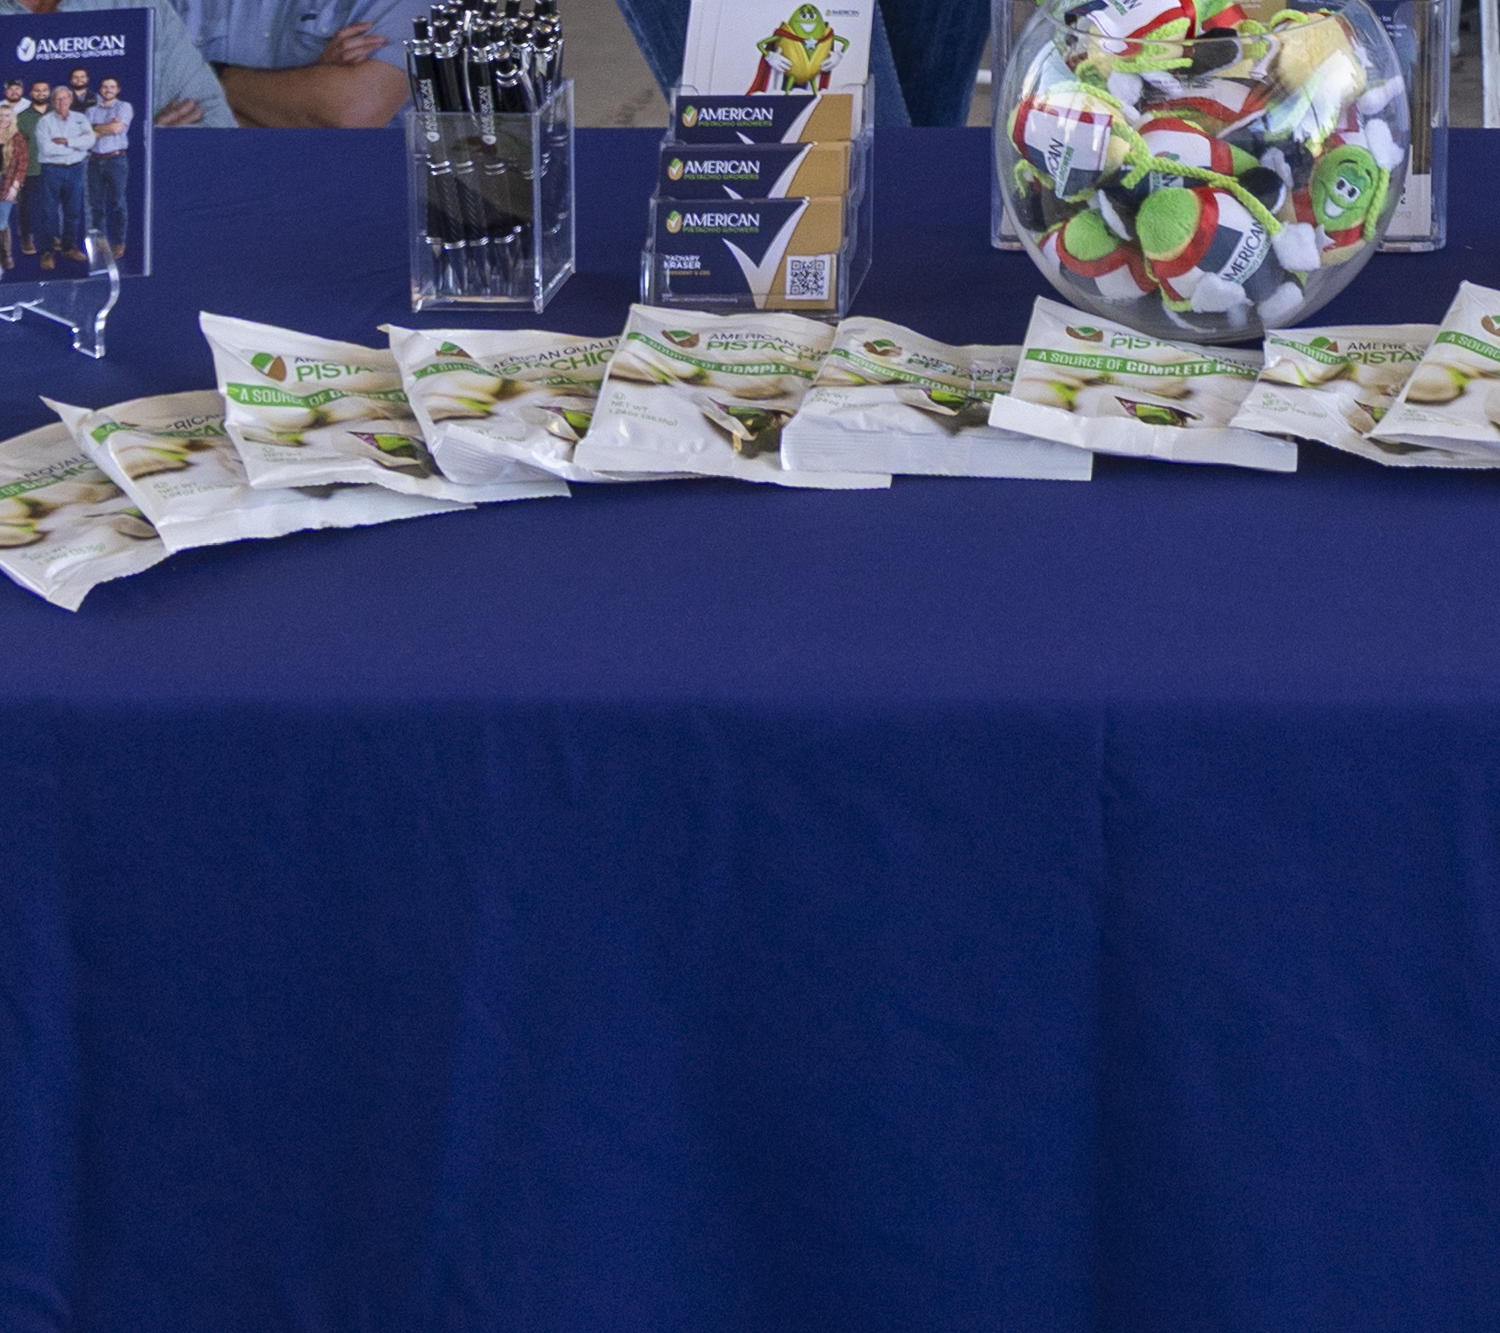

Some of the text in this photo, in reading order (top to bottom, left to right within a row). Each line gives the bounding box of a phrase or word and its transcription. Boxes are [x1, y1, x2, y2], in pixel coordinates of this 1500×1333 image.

[36, 35, 126, 53] AMERICAN
[698, 107, 773, 121] AMERICAN
[684, 160, 760, 175] AMERICAN
[683, 213, 760, 227] AMERICAN
[1448, 333, 1456, 342] A
[563, 338, 620, 356] QUALIT
[1038, 350, 1048, 361] A
[1050, 352, 1101, 369] SOURCE
[1106, 359, 1123, 371] OF
[1126, 360, 1211, 376] COMPLETE
[240, 388, 250, 402] A
